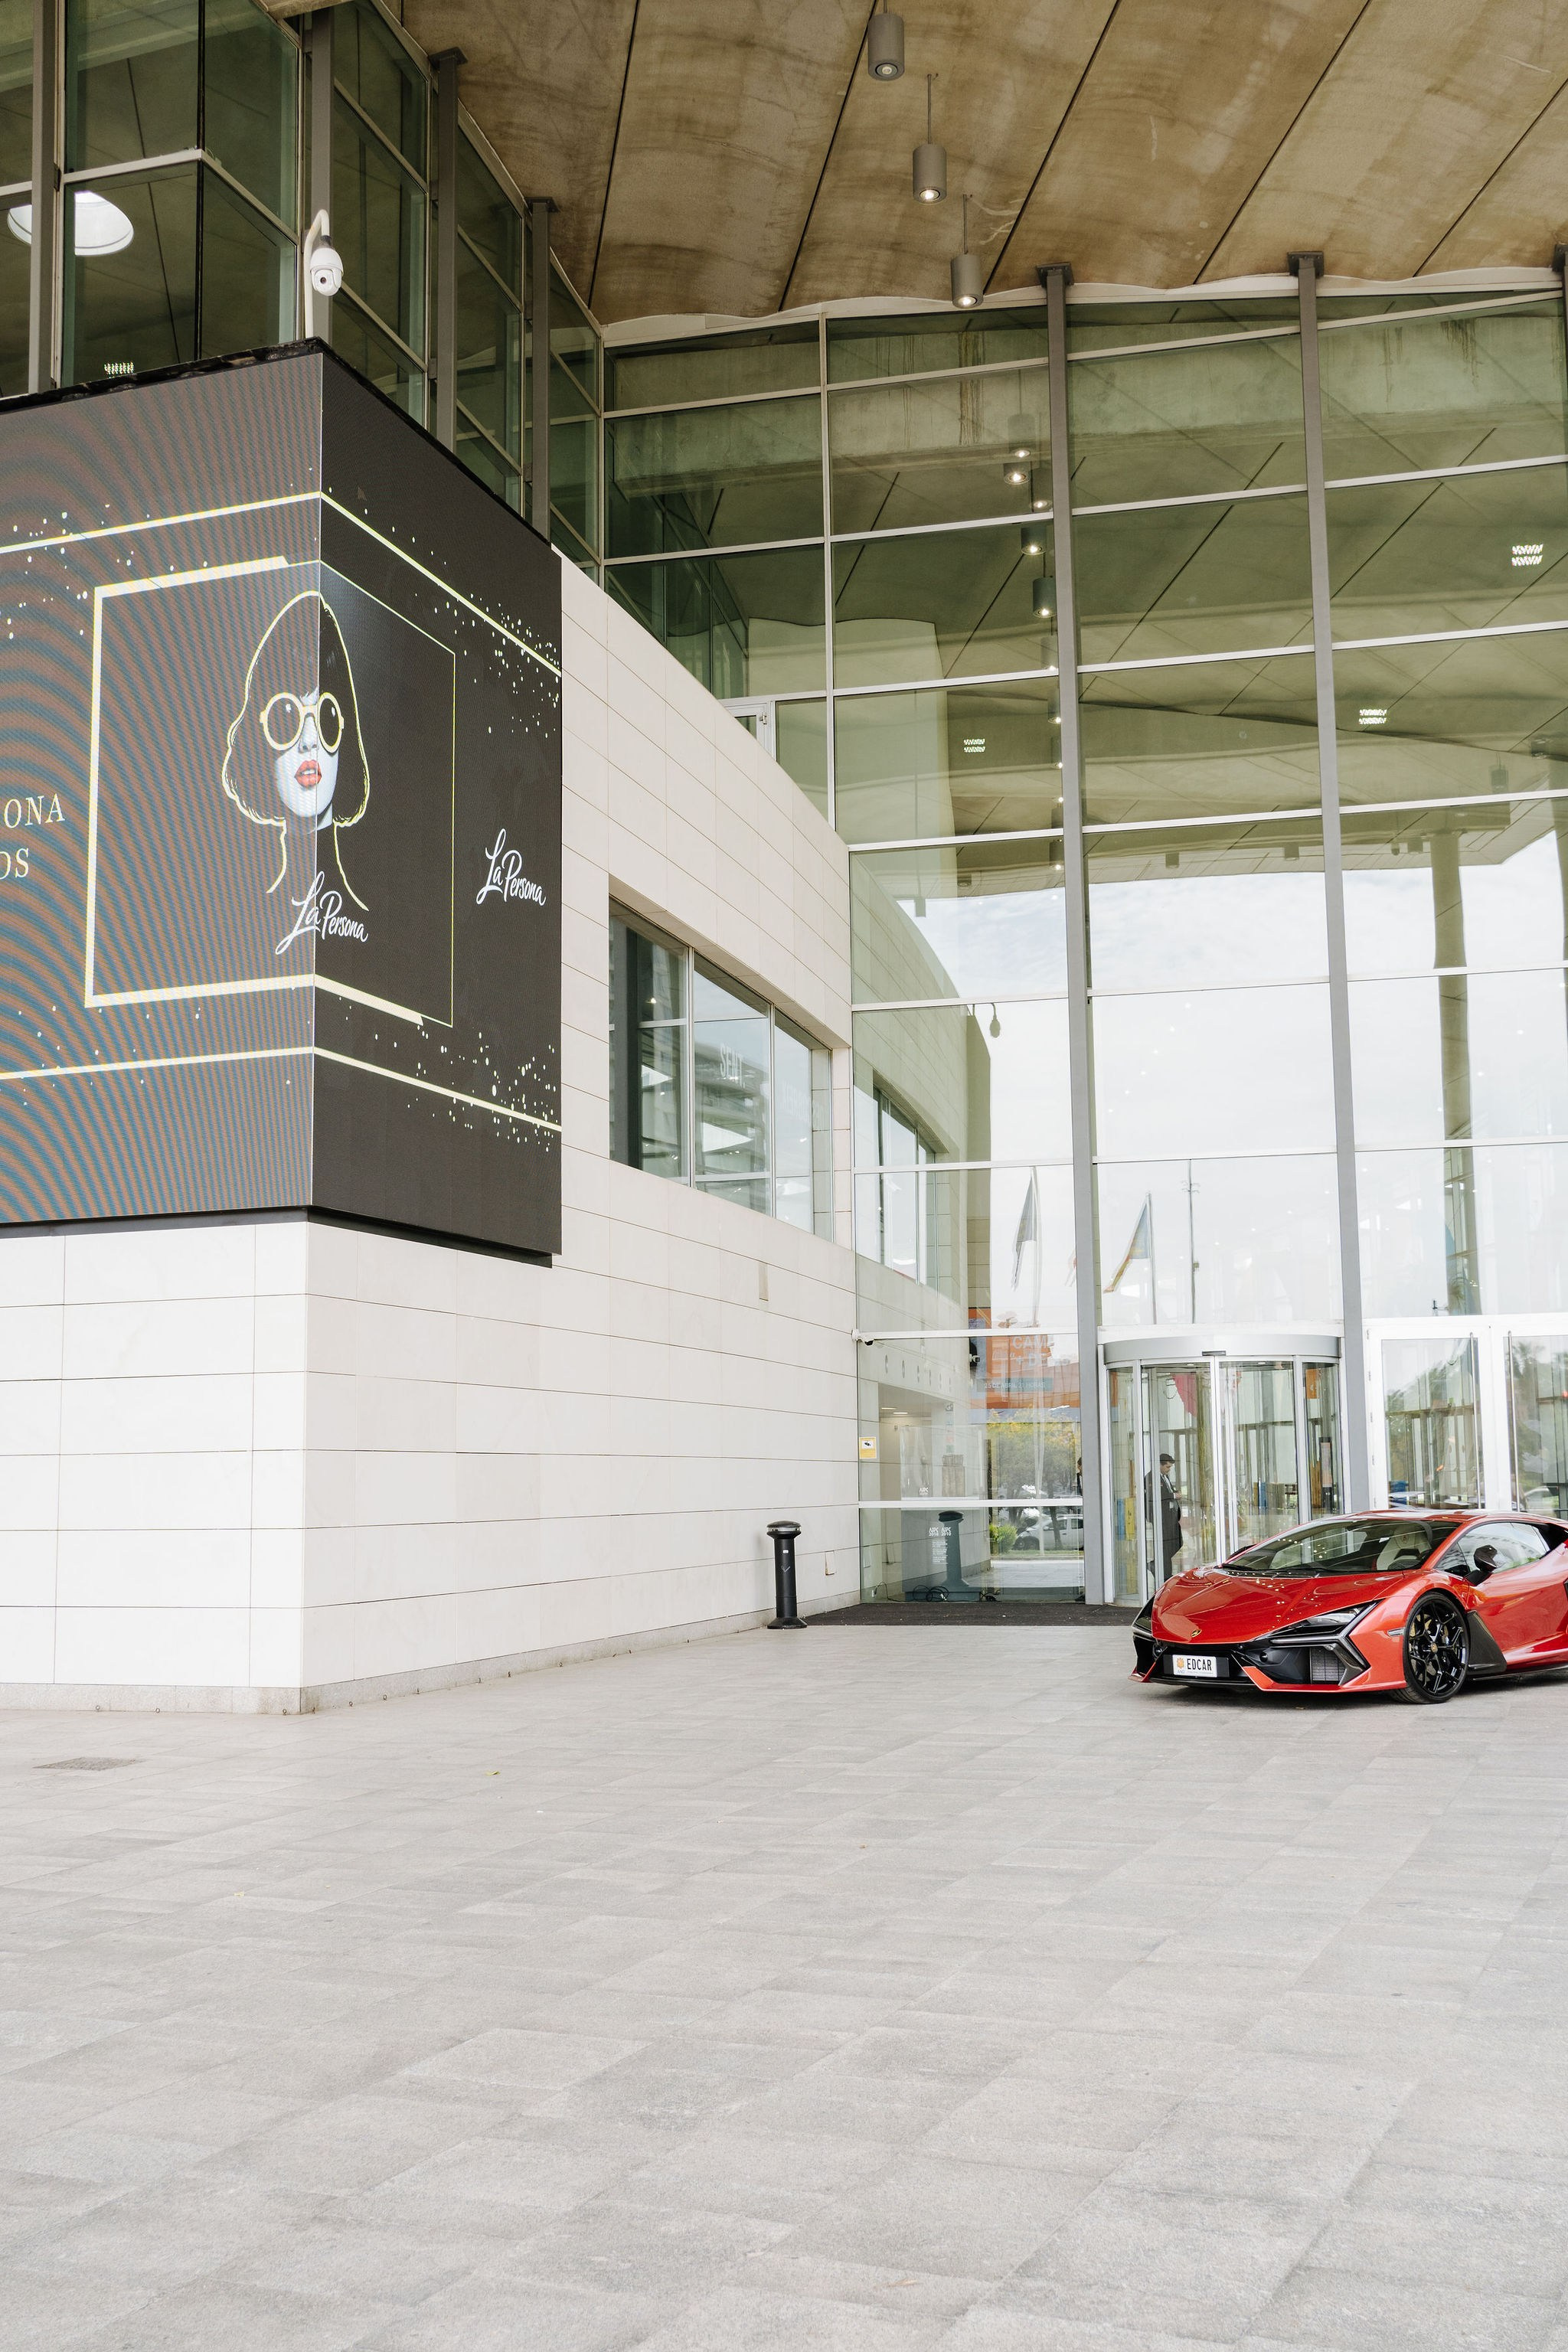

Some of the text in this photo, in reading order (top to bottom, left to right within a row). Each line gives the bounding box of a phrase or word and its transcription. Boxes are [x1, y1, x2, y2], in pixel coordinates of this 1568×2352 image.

[4, 793, 66, 828] ONA
[476, 828, 546, 906] La Persona
[276, 871, 368, 955] La Persona
[1187, 1658, 1212, 1671] EDCAR
